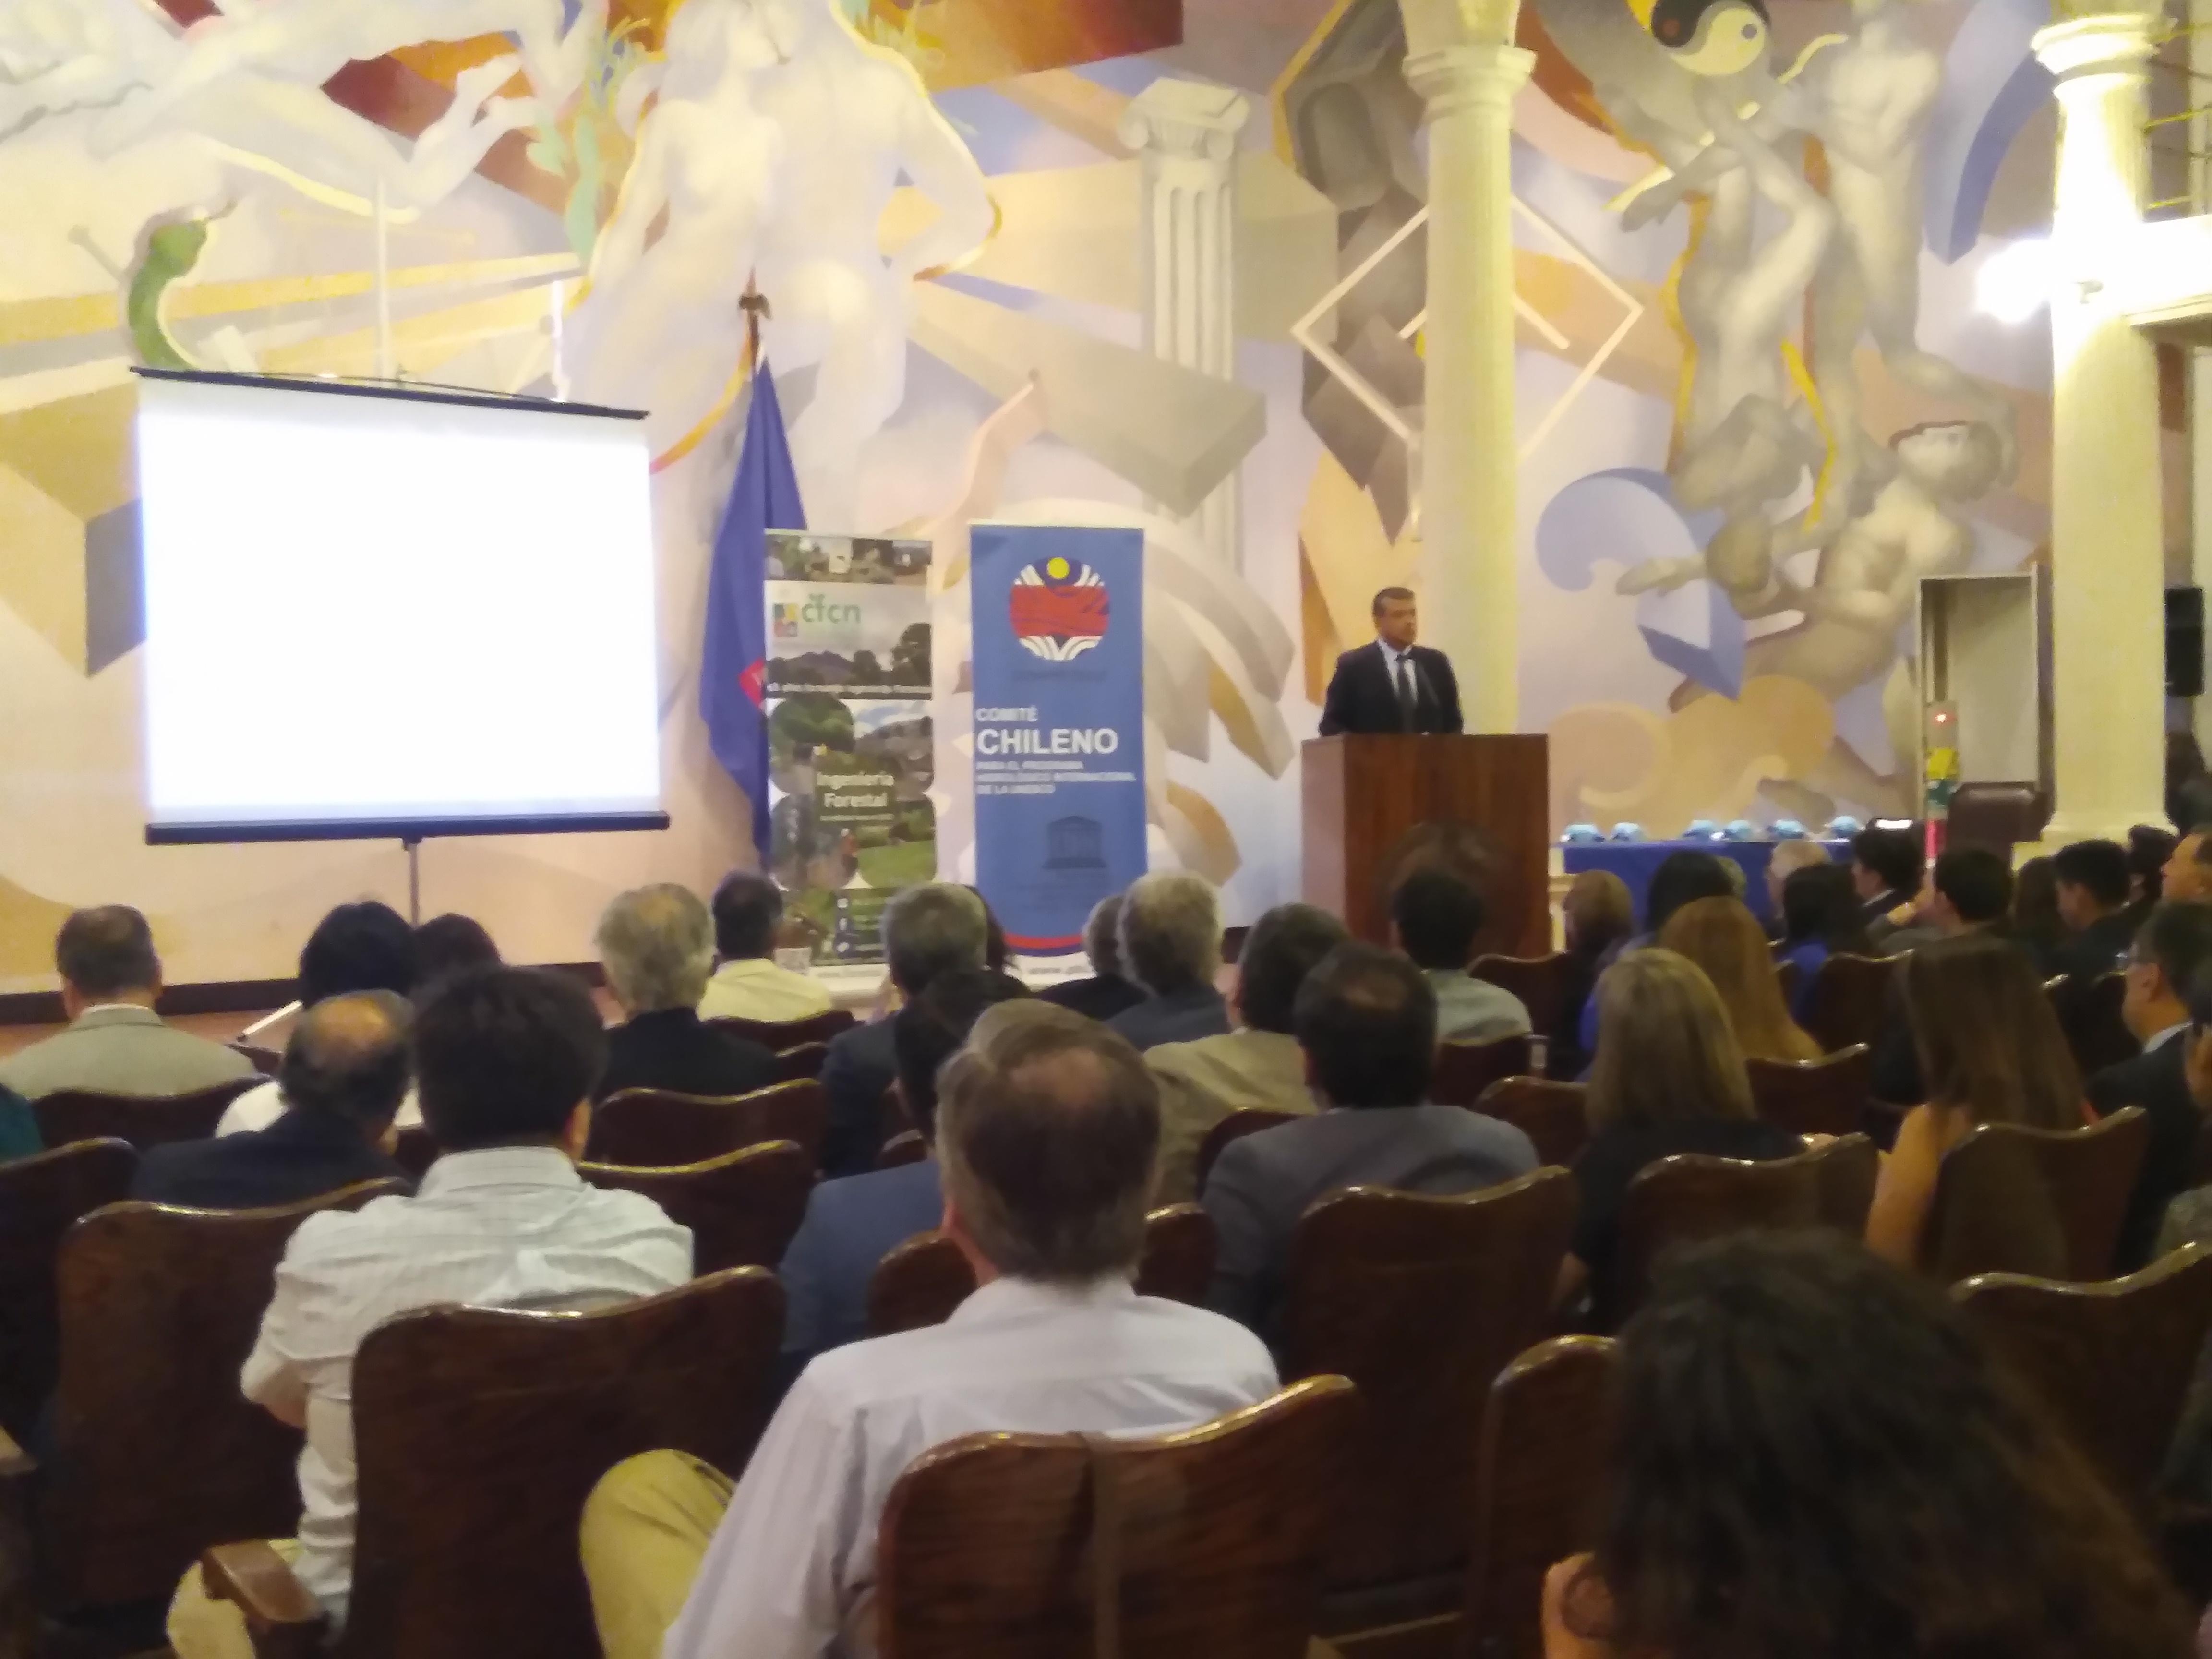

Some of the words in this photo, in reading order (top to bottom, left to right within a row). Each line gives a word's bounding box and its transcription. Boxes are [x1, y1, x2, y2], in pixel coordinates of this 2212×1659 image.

[976, 706, 1038, 721] COMITÉ
[978, 728, 1118, 755] CHILENO
[824, 793, 888, 808] Forestal
